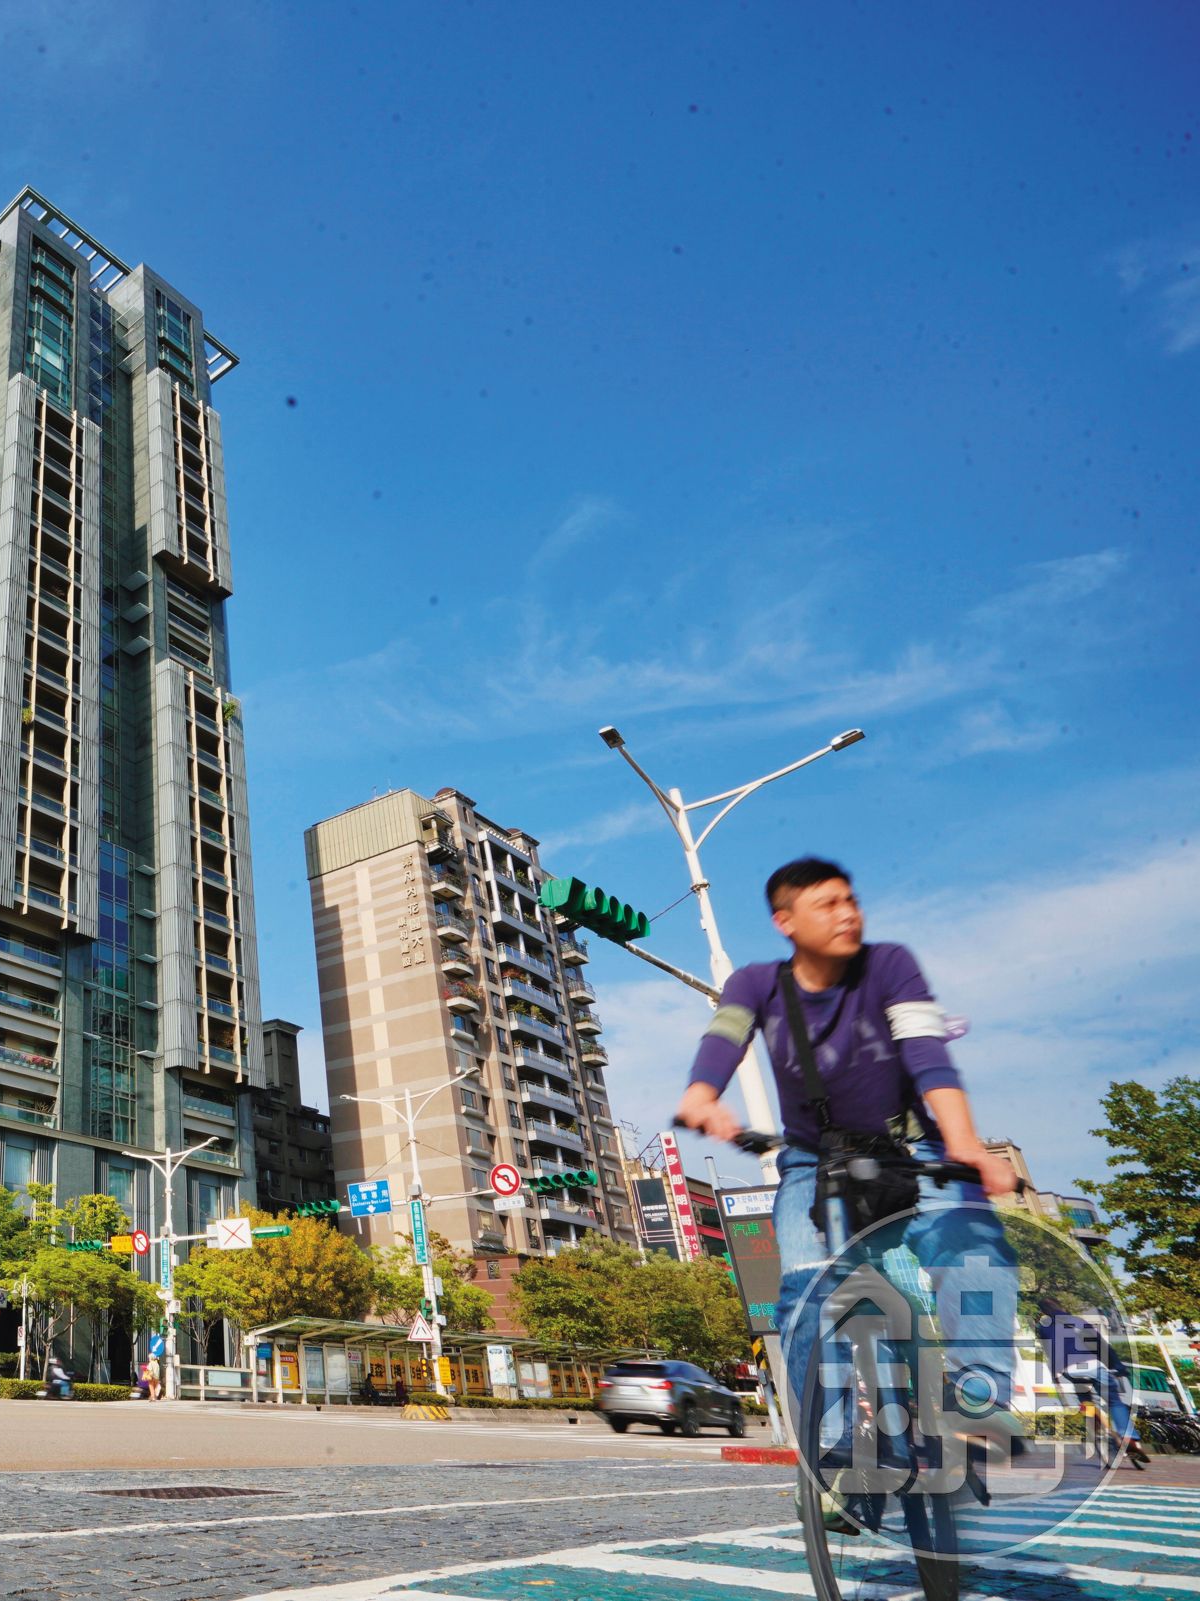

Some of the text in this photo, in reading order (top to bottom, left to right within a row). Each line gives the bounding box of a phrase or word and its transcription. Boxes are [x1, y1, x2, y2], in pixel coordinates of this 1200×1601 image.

[351, 1189, 389, 1202] 公車專用
[725, 1196, 736, 1214] P
[732, 1222, 761, 1238] 汽車
